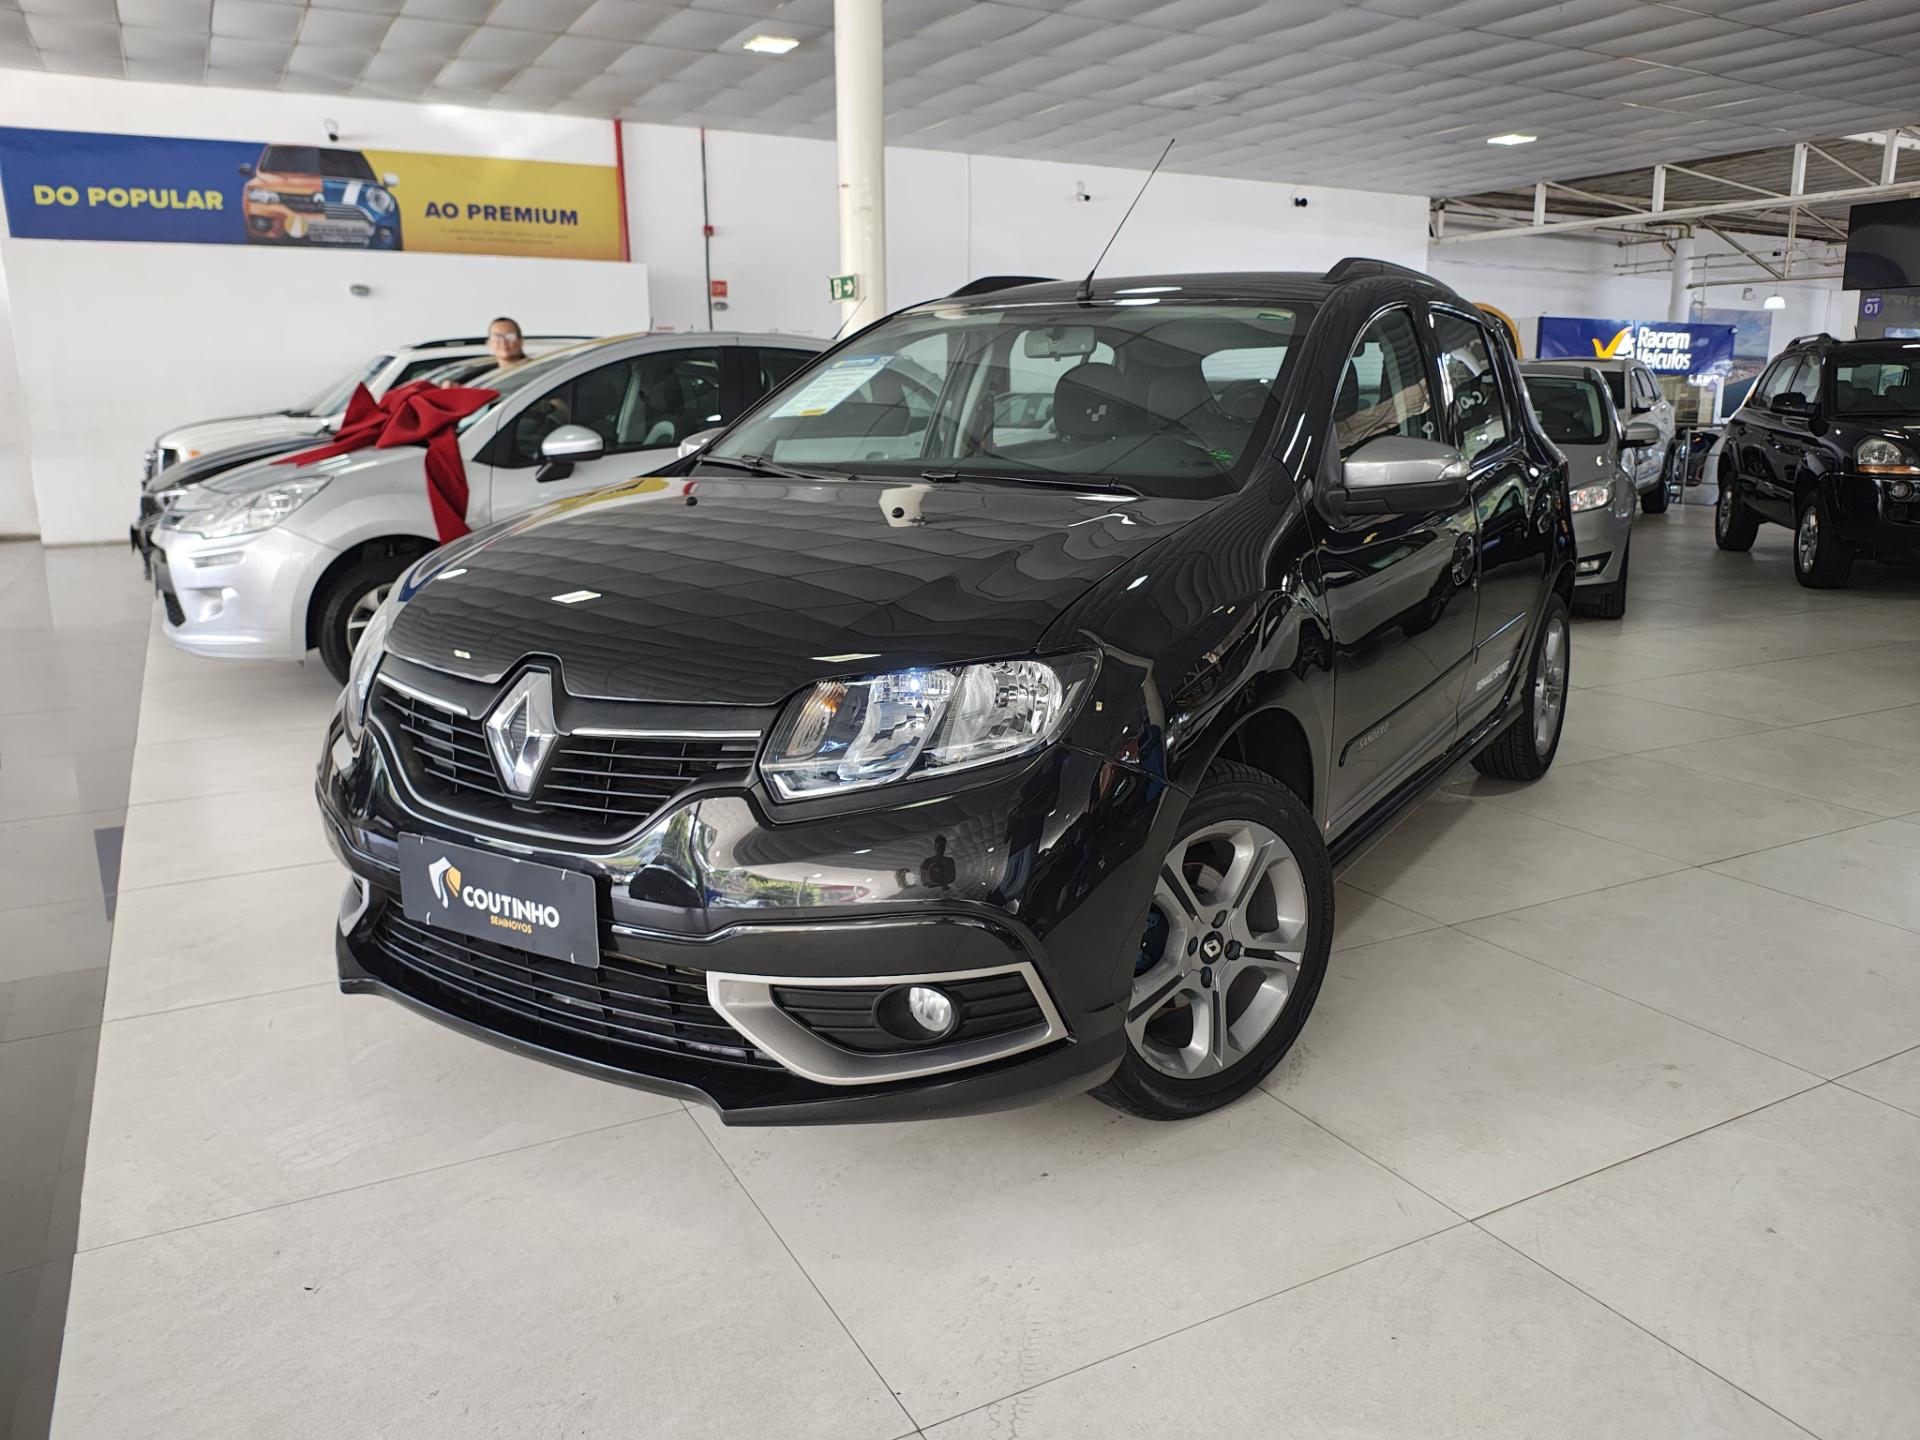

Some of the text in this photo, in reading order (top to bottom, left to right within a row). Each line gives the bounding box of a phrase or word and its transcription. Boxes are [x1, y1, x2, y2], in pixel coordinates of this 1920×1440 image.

[33, 185, 224, 211] DO POPULAR
[424, 200, 579, 226] AO PREMIUM
[1637, 326, 1690, 350] Racram
[462, 885, 561, 928] COUTINHO
[490, 915, 533, 935] SEMINOVOS
